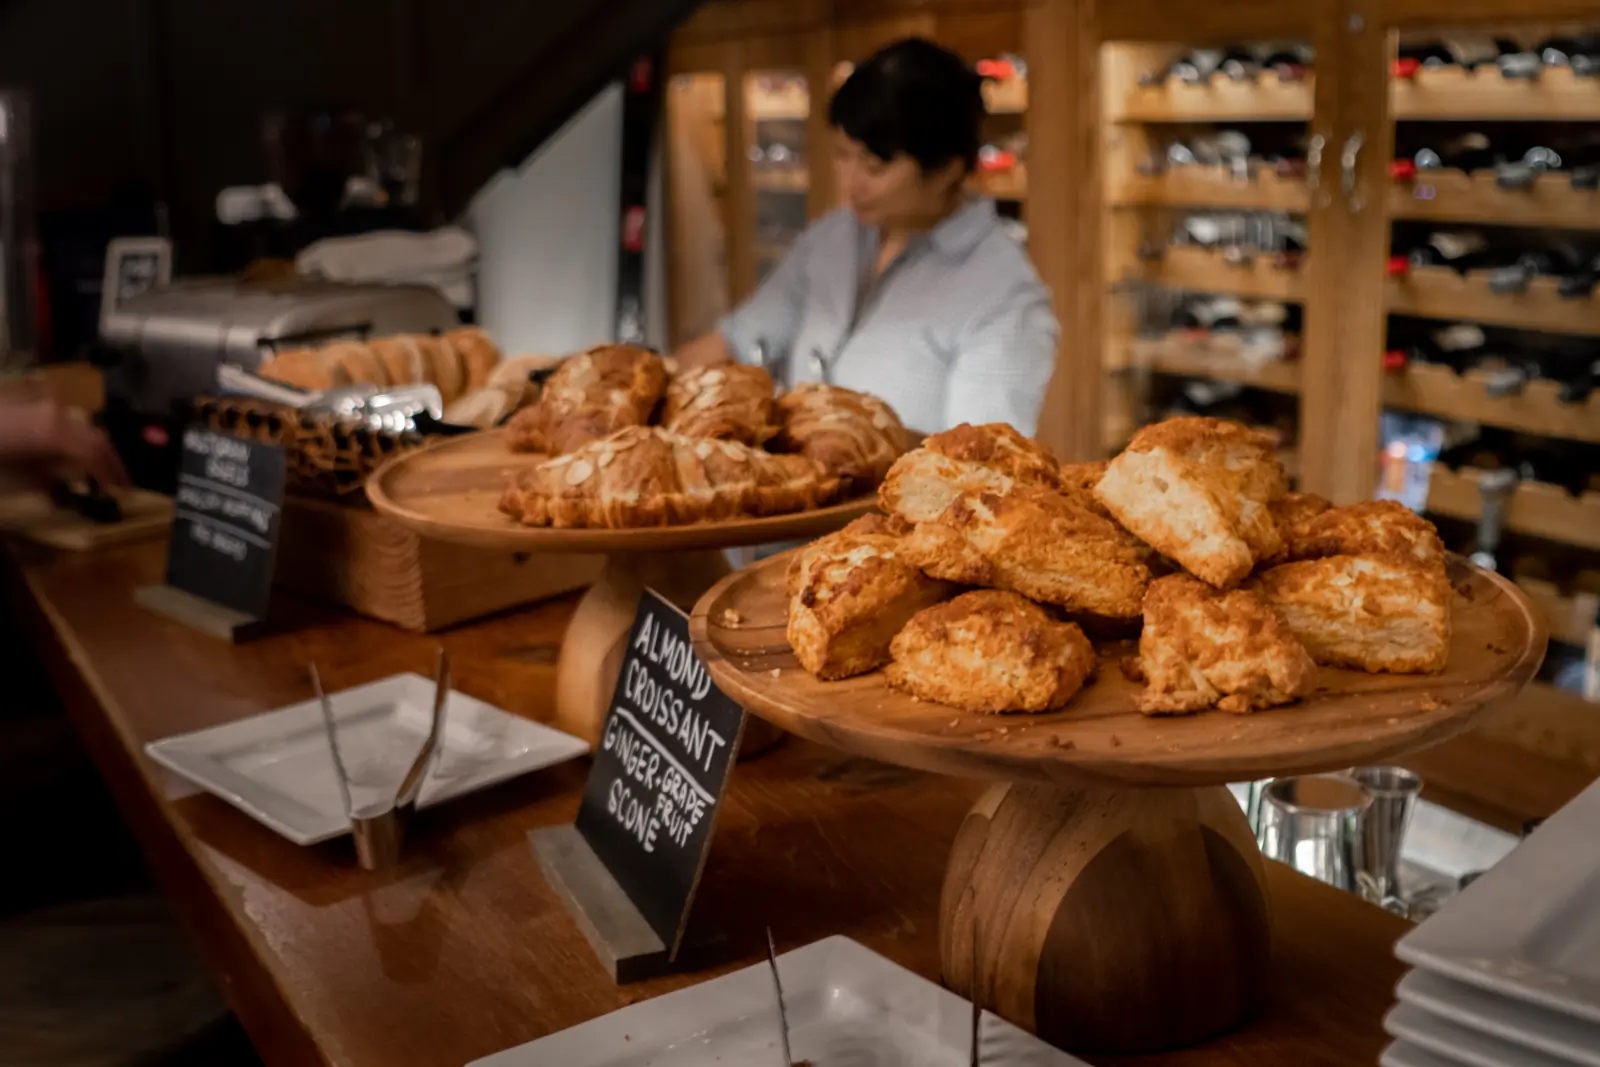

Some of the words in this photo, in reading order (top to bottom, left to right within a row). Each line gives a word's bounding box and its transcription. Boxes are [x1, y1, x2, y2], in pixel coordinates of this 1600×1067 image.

[634, 612, 712, 700] ALMOND
[624, 658, 726, 772] CROISSANT
[608, 778, 661, 853] SCONE
[656, 794, 693, 848] FRUIT
